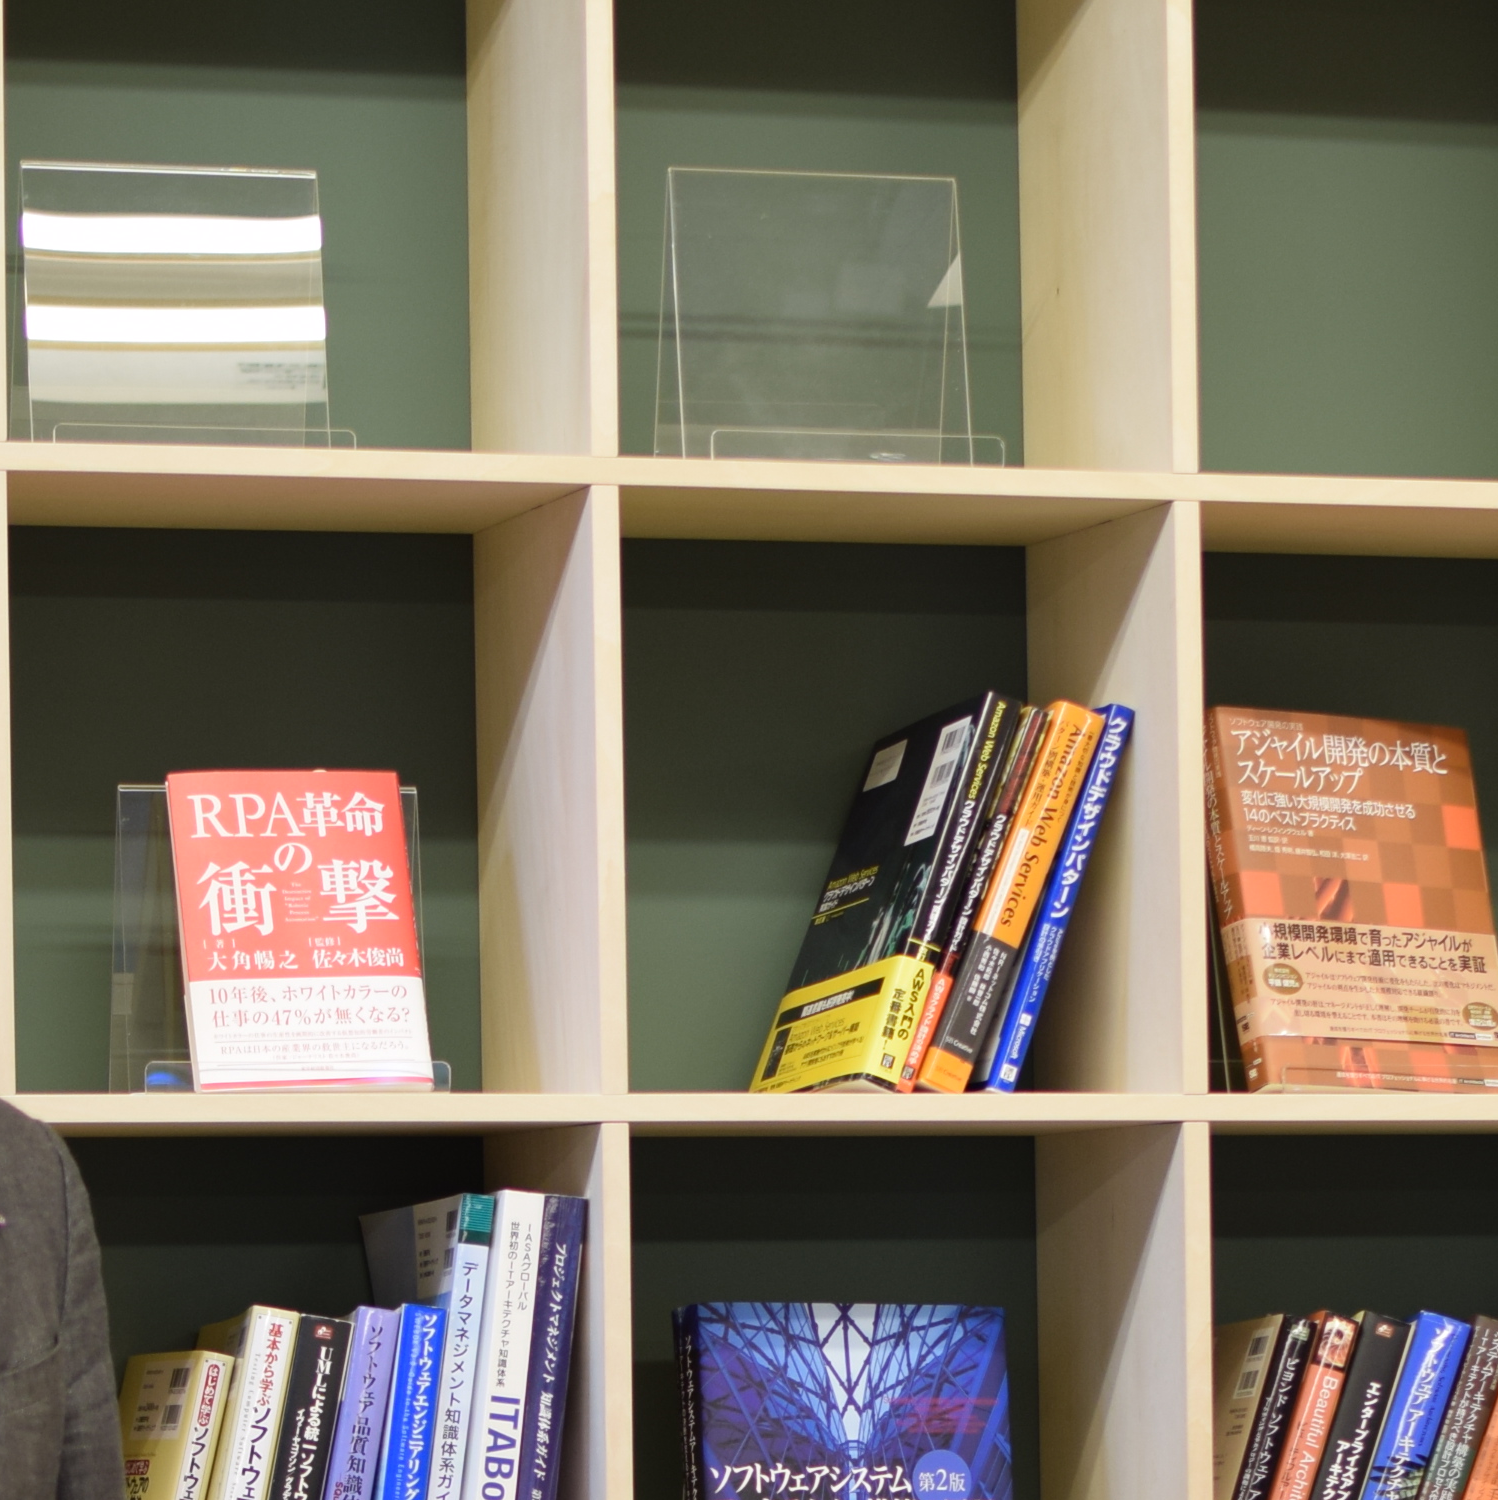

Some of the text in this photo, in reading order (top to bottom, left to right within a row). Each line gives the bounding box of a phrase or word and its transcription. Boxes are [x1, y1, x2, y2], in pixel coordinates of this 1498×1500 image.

[1231, 728, 1448, 774] アジャイル開発の本質と
[1238, 759, 1364, 794] スケールアップ
[187, 792, 385, 838] RPA革命
[1051, 716, 1127, 918] クラウドデザインパターン
[1242, 790, 1415, 819] 変化に強い大規模開発を成功させる
[1245, 808, 1356, 830] 14のベストプラクティス
[1001, 724, 1086, 927] Amazon Web Services
[274, 843, 312, 874] の
[312, 947, 404, 969] 佐々木俊尚
[1263, 943, 1487, 973] 企業レベルにまで適用できることを実証
[209, 984, 407, 1004] 10年後、ホワイトカラーの
[898, 968, 924, 1041] AWS入門の
[495, 1221, 521, 1388] 世界初のITアーキテクチャ知識体系
[544, 1243, 567, 1383] プロジェクトマネジメント
[257, 1323, 284, 1407] 基本から学ぶ
[1306, 1375, 1339, 1449] Beautiful
[710, 1463, 912, 1494] ソフトウェアシステム
[918, 1471, 966, 1492] 第2版
